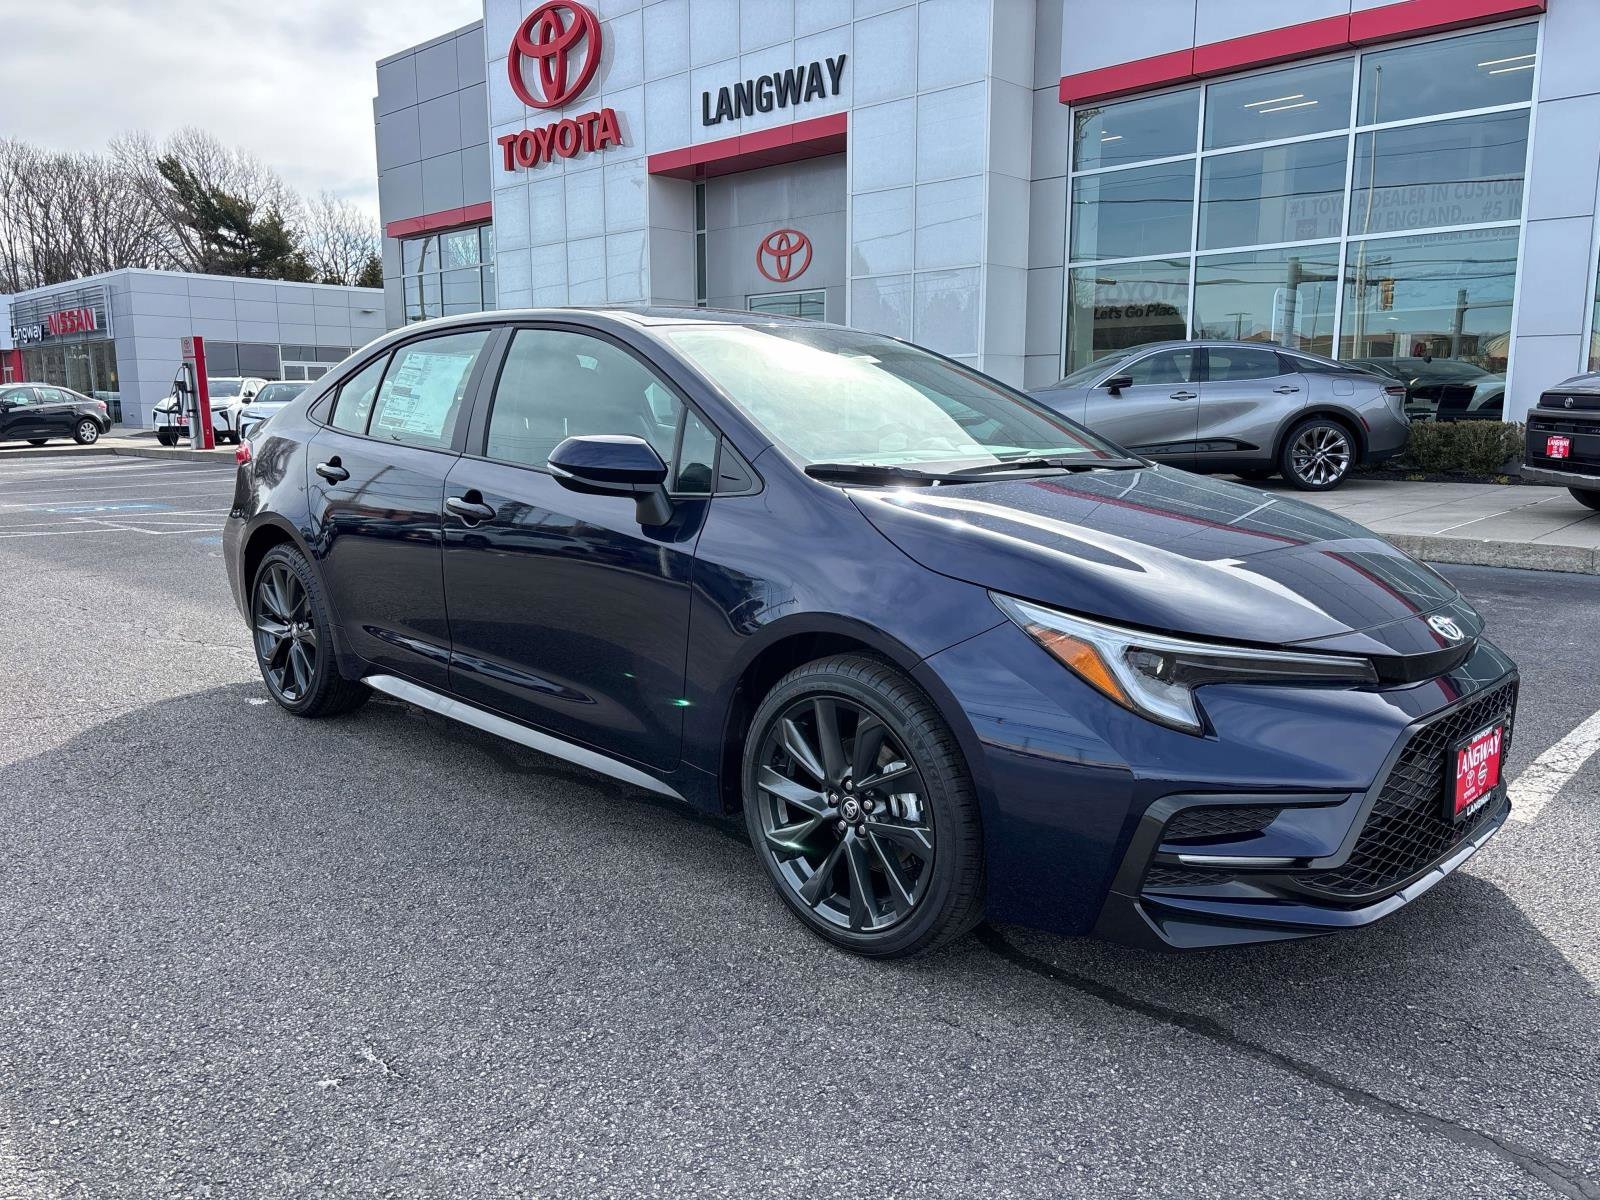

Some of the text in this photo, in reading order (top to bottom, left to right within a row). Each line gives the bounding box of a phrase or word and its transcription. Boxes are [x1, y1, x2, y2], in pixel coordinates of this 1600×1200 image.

[702, 54, 847, 127] LANGWAY
[498, 108, 625, 172] TOYOTA
[1431, 184, 1449, 202] IN
[47, 307, 97, 336] NISSAN
[1124, 305, 1144, 319] Go
[1457, 731, 1502, 779] LANGWAY
